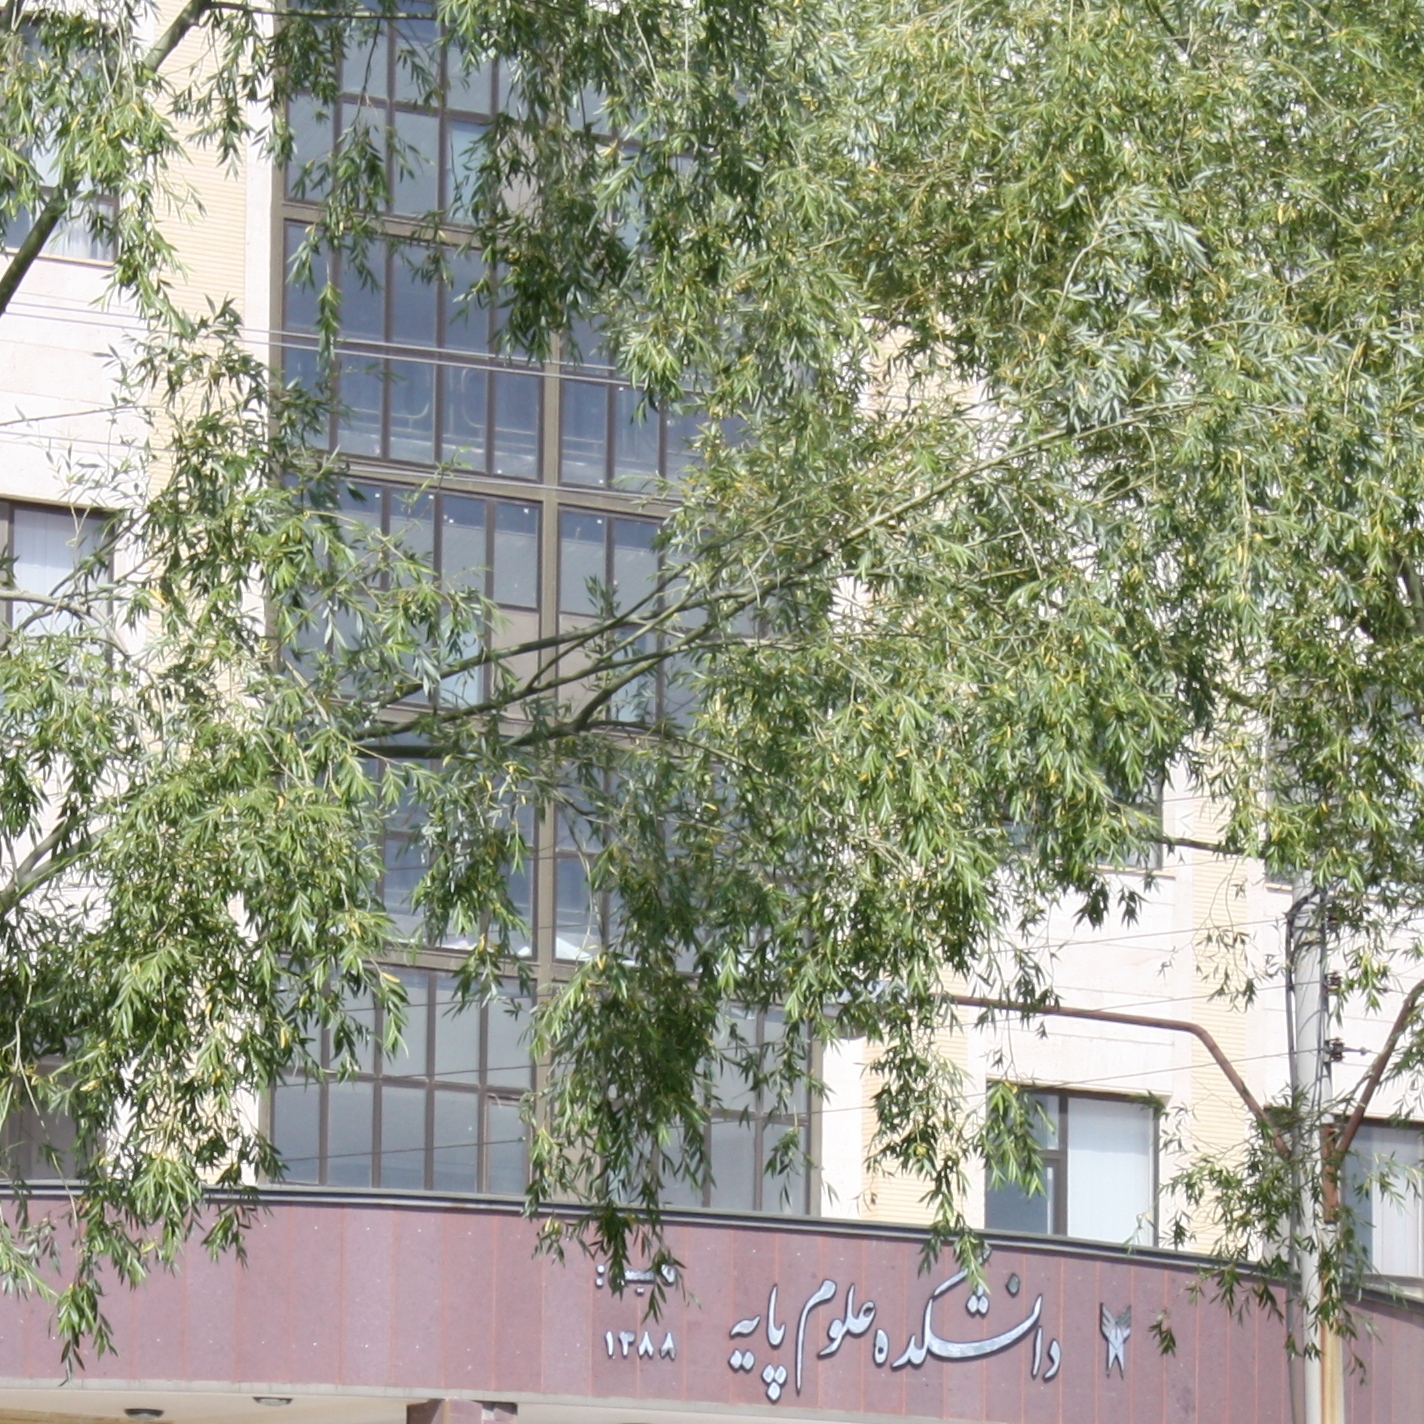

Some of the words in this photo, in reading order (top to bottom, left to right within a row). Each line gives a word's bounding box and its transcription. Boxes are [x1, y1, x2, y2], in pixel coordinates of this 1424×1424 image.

[727, 1283, 789, 1404] پایه
[795, 1278, 877, 1397] علوم
[874, 1243, 1062, 1382] دانشکده
